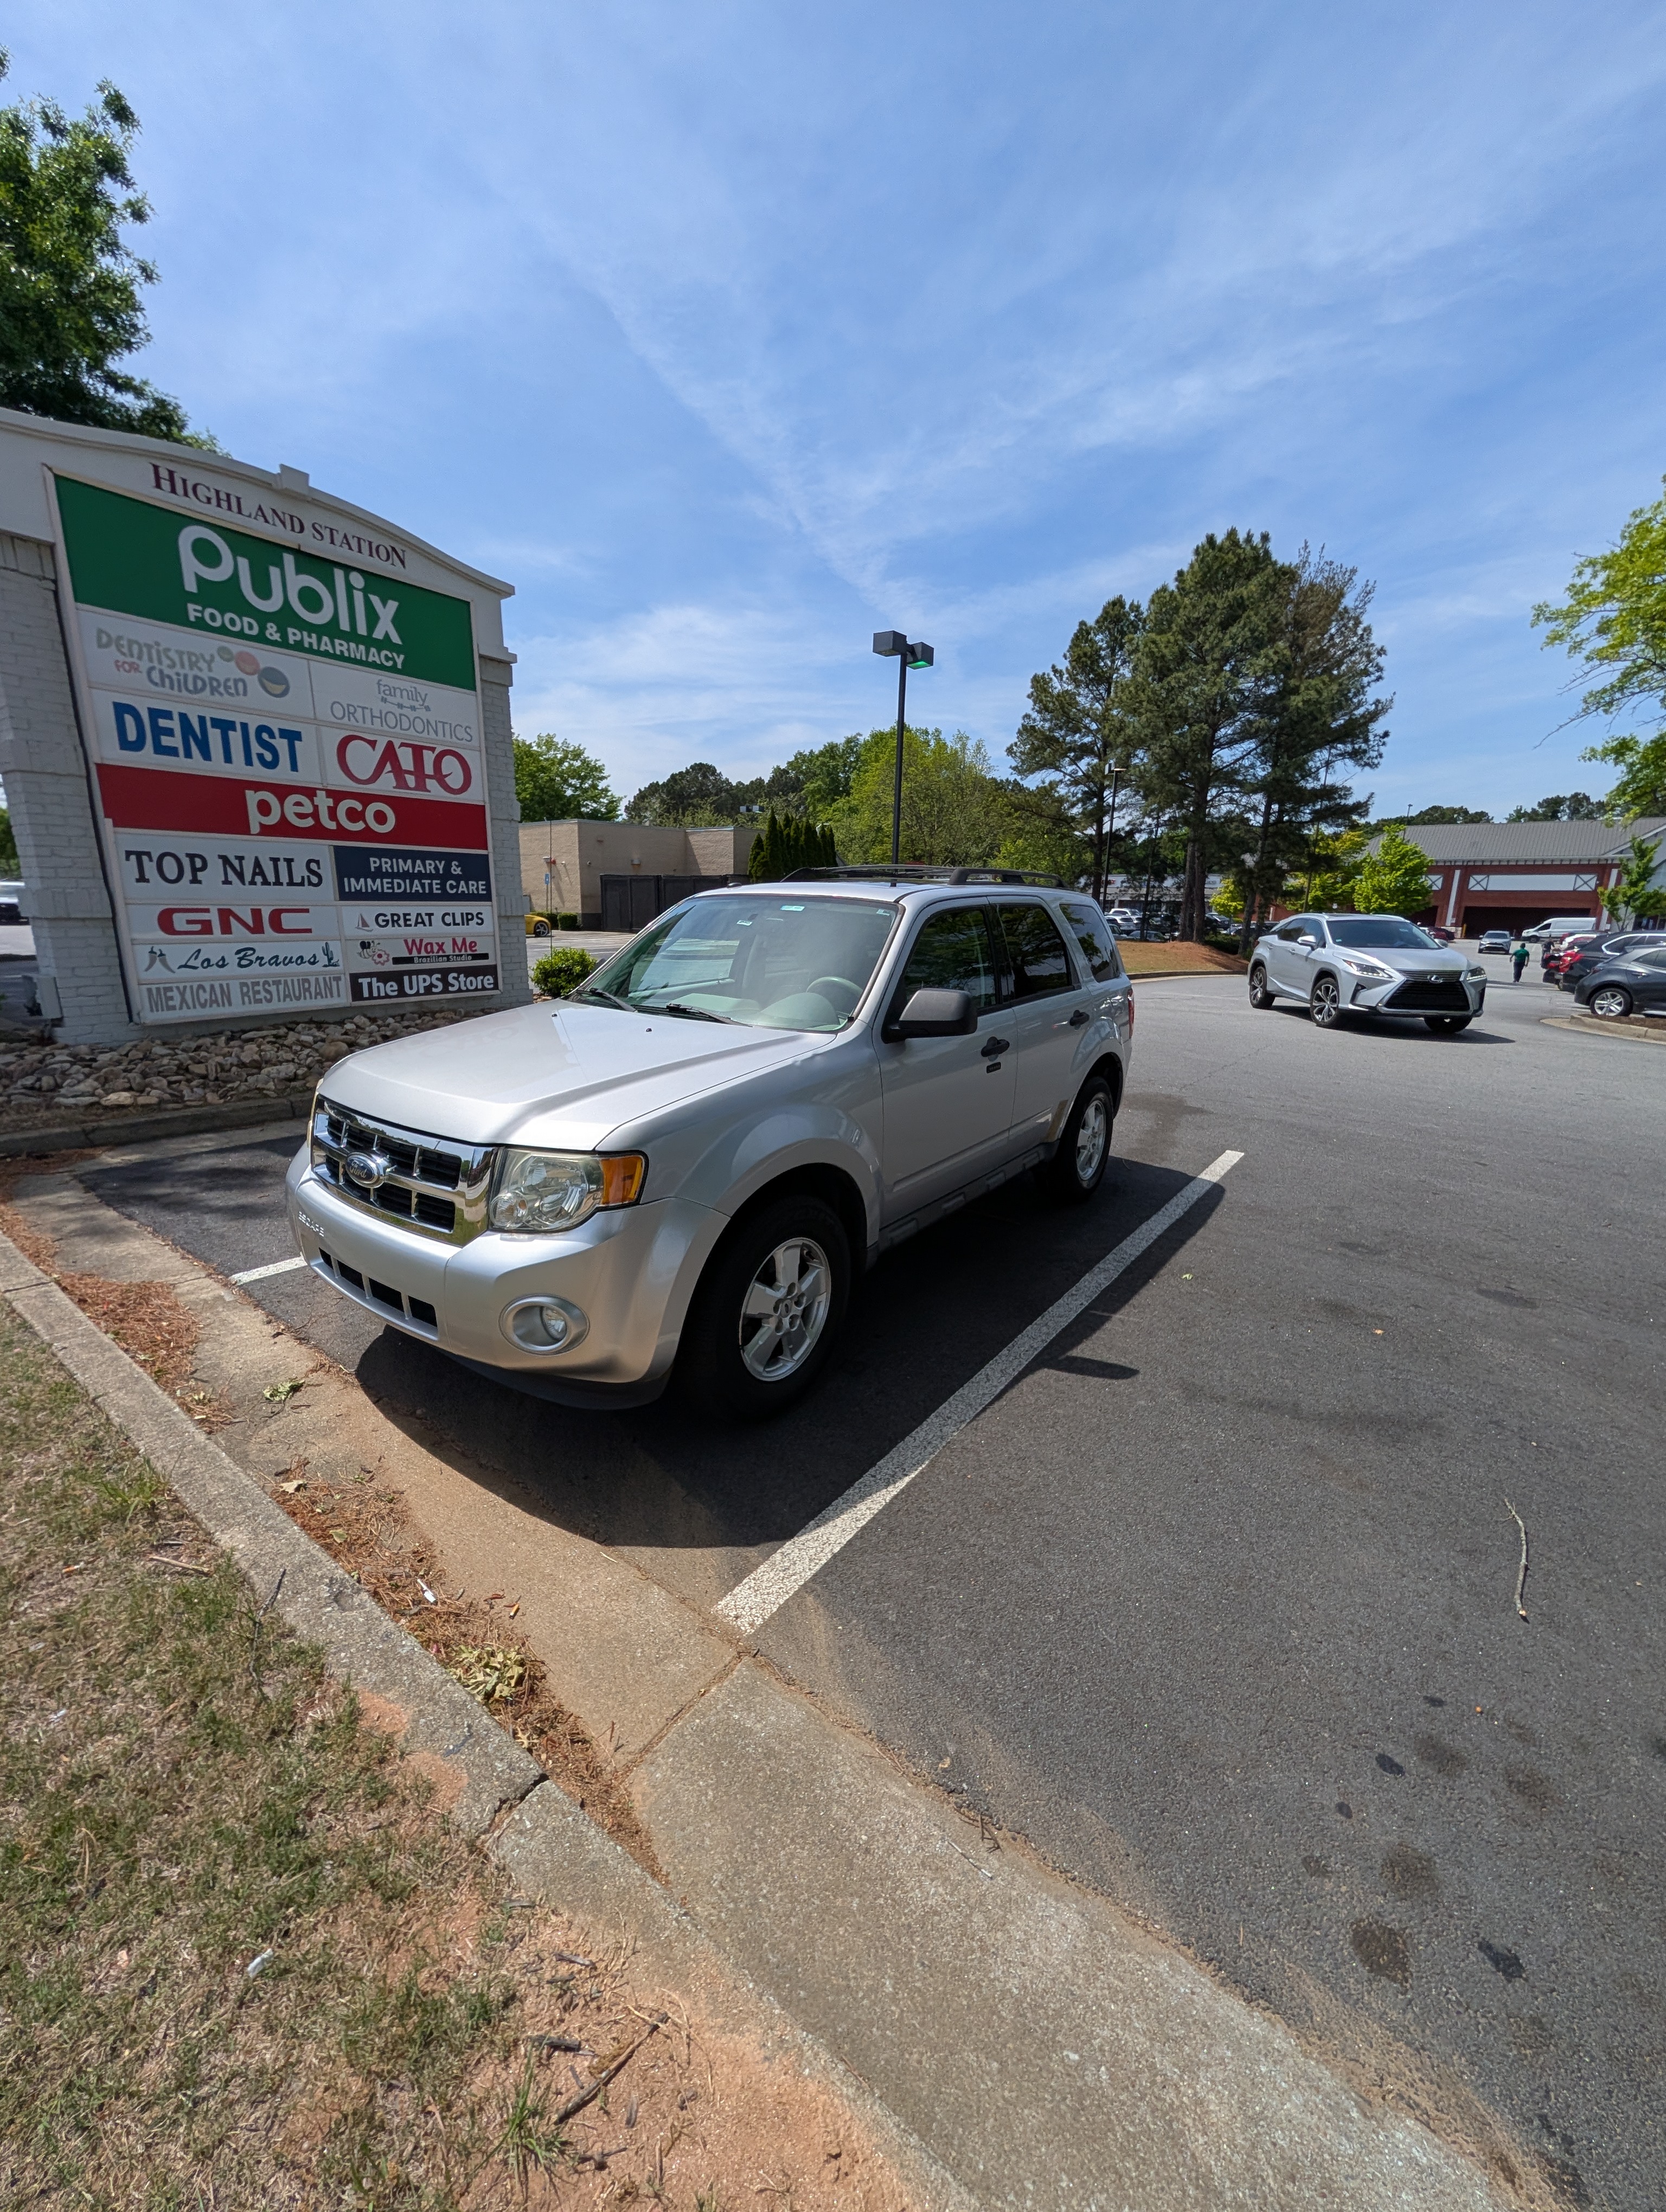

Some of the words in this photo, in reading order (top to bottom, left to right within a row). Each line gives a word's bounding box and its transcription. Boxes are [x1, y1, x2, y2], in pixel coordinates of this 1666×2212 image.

[149, 462, 305, 534] HIGHLAND
[311, 522, 406, 569] STATION
[178, 525, 402, 645] Publix
[187, 602, 259, 636] FOOD
[265, 622, 281, 642] &
[287, 627, 405, 670] PHARMACY
[114, 659, 143, 674] FOR
[376, 679, 428, 705] family
[330, 700, 473, 743] ORTHODONTICS
[112, 701, 302, 773] DENTIST
[336, 734, 472, 795] CATO
[245, 789, 396, 834] petco
[125, 850, 208, 885] TOP
[218, 854, 323, 888] NAILS
[369, 857, 445, 874] PRIMARY
[451, 861, 462, 874] &
[343, 877, 441, 894] IMMEDIATE
[446, 880, 486, 895] CARE
[157, 907, 312, 936] GNC
[374, 912, 434, 928] GREAT
[441, 912, 484, 926] CLIPS
[177, 948, 229, 970] Los
[234, 947, 319, 969] Bravos
[403, 938, 449, 955] Wax
[452, 937, 477, 953] Me
[414, 954, 447, 964] Brazilian
[449, 954, 472, 962] Studio
[146, 982, 232, 1013] MEXICAN
[239, 975, 342, 1006] RESTAURANT
[358, 978, 398, 998] The
[403, 974, 443, 995] UPS
[448, 973, 494, 992] Store
[349, 1160, 368, 1179] Ford
